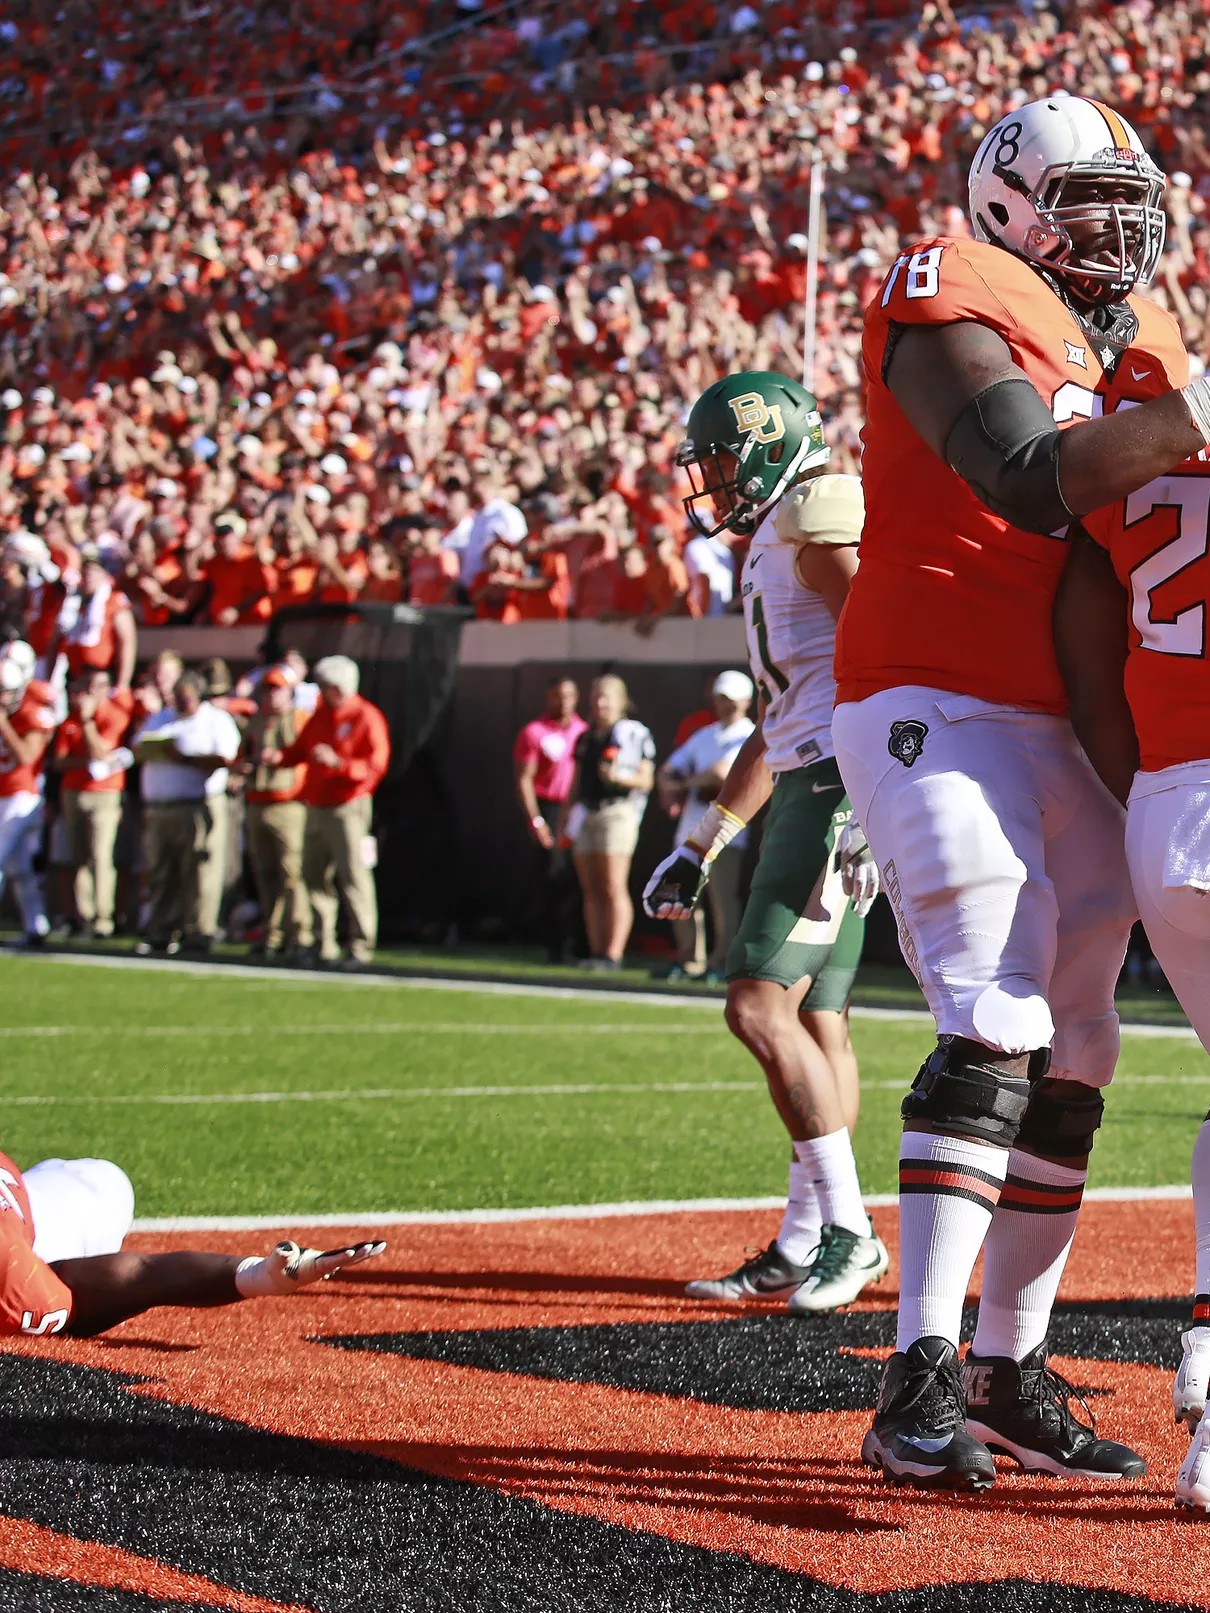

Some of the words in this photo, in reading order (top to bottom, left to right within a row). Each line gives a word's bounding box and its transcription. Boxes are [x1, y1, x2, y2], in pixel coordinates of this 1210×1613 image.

[977, 121, 1023, 168] 78
[881, 245, 945, 309] 78
[727, 391, 787, 445] BU
[834, 809, 855, 824] BA
[21, 1308, 69, 1337] 5
